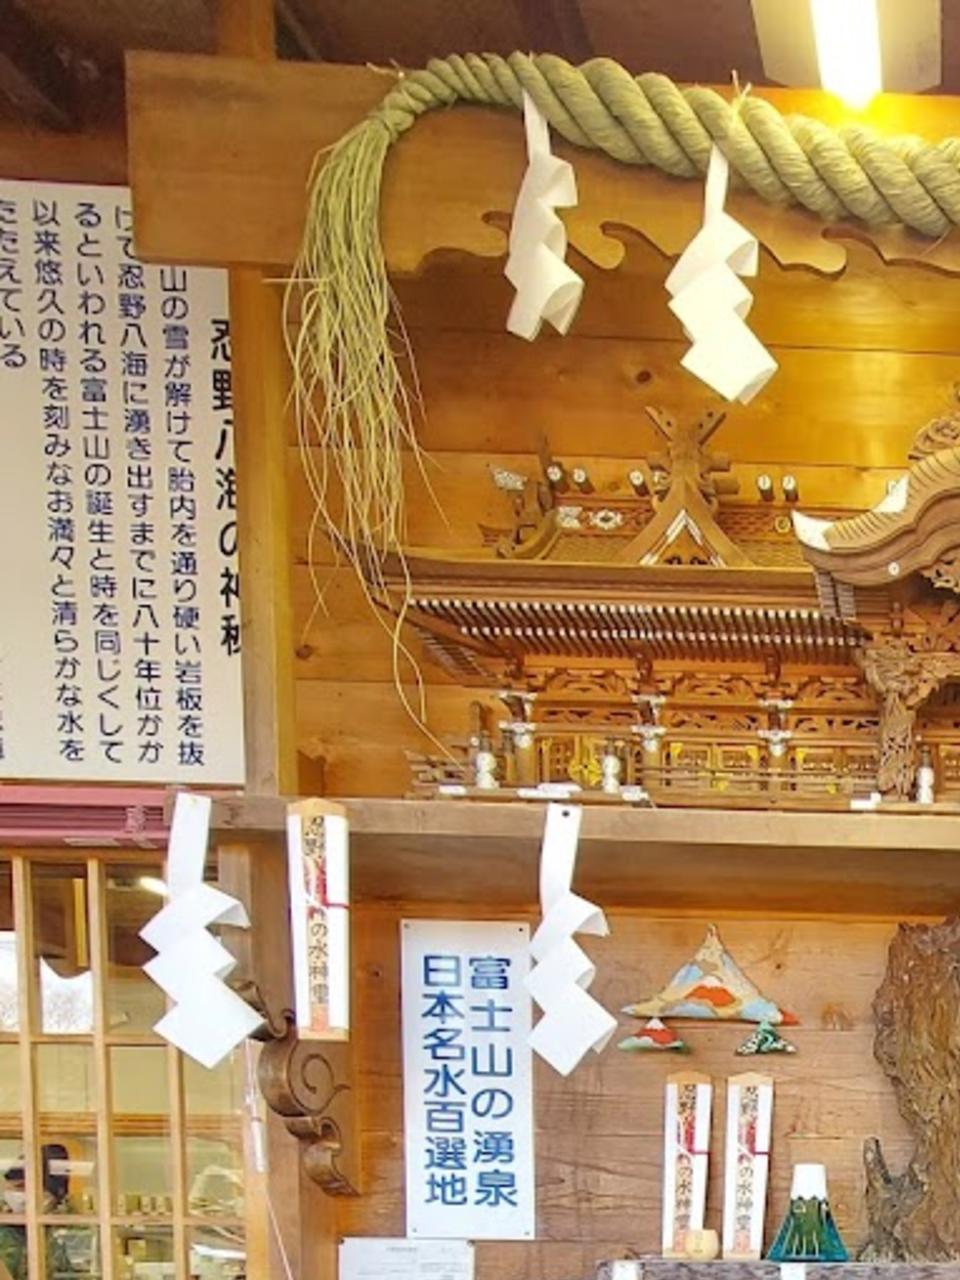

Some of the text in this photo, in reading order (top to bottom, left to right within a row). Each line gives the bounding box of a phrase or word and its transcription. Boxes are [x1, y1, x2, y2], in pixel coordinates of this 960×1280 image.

[32, 200, 85, 762] 以来悠久の時を刻みなお満々と清らかな水を
[74, 202, 123, 764] るといわれる富士山の誕生と時を同じくして
[421, 955, 468, 1206] 日本名水百選地
[468, 956, 518, 1207] 富士山の湧泉
